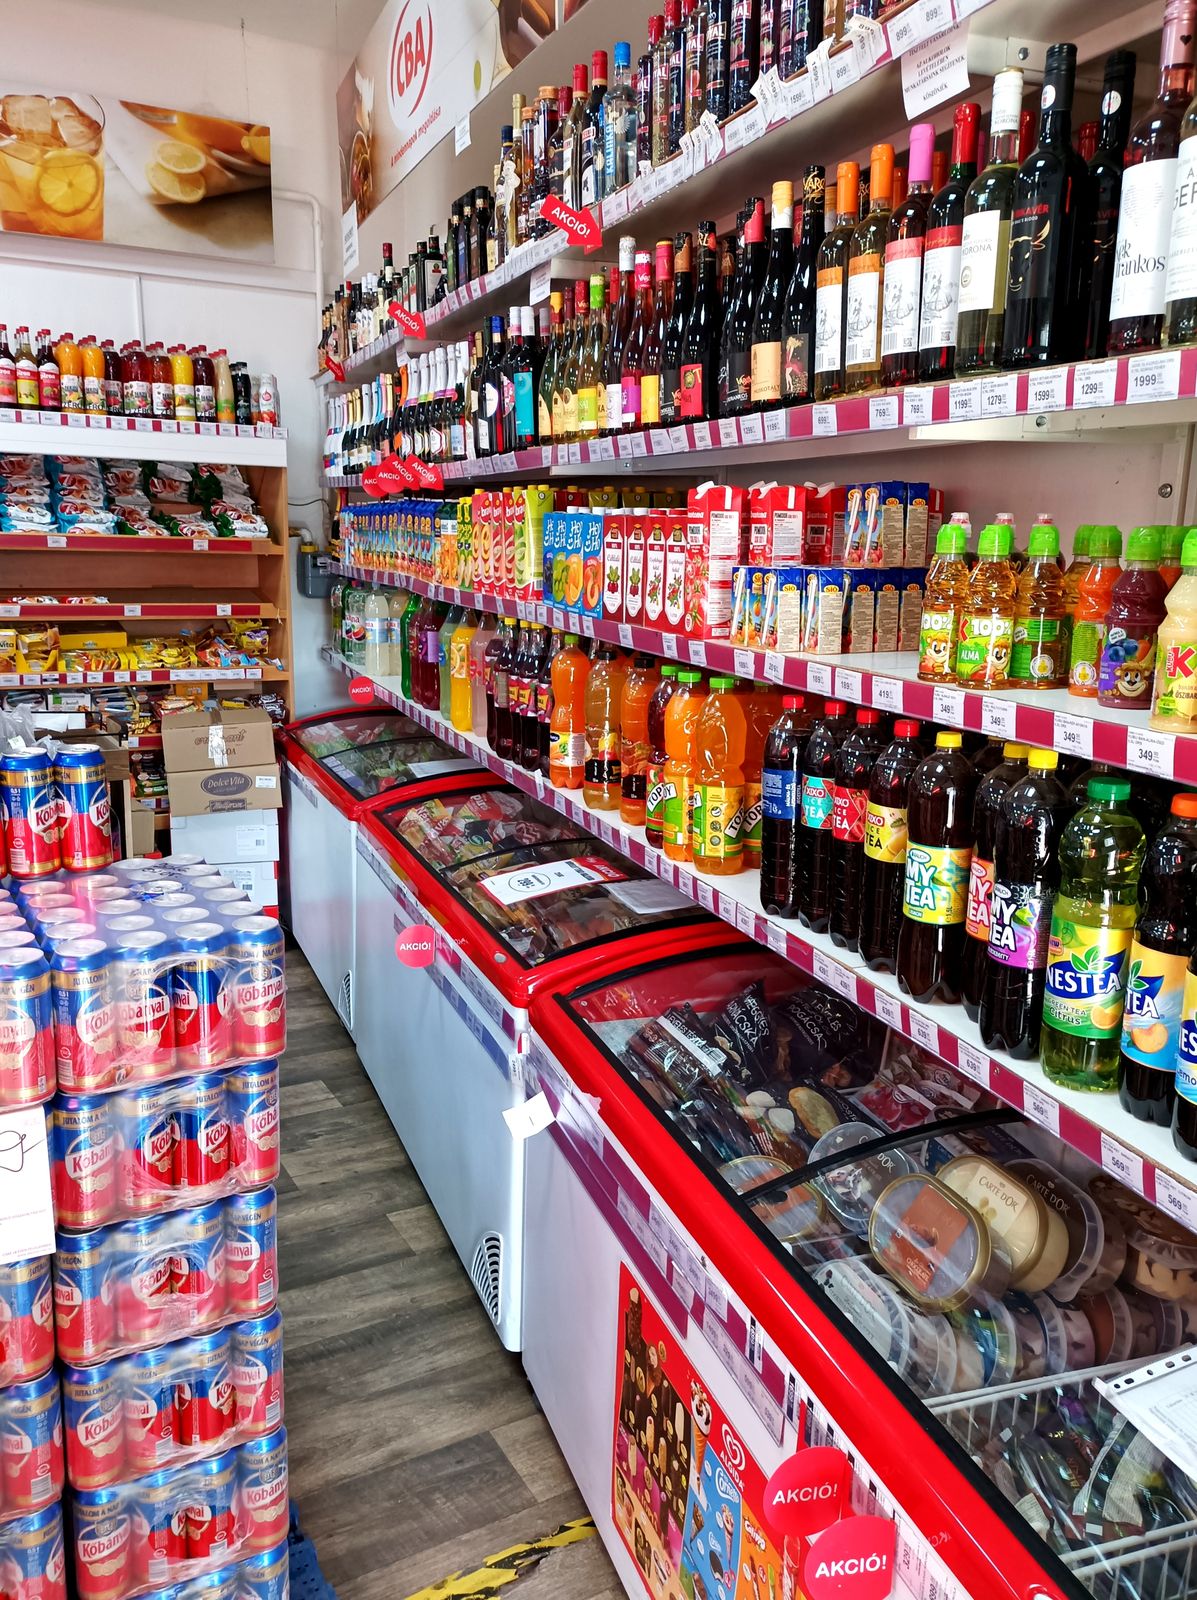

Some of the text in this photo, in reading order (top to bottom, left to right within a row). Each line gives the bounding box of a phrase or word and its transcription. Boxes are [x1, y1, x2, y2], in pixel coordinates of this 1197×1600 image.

[926, 8, 938, 21] 899
[896, 27, 908, 41] 899
[397, 16, 425, 97] CBA
[551, 202, 592, 239] AKCIÓ!
[394, 307, 420, 332] AKCIÓ!
[1081, 382, 1098, 395] 1299
[1134, 374, 1157, 388] 1999
[987, 394, 1002, 406] 1279
[1034, 389, 1050, 402] 1599
[910, 405, 920, 414] 769
[954, 399, 968, 410] 1199
[875, 408, 887, 418] 769
[392, 461, 414, 482] AKCIÓ!
[411, 461, 437, 484] AKCIÓ!
[971, 618, 1012, 636] 100%
[961, 650, 980, 661] ALMA
[1167, 646, 1195, 678] K
[351, 684, 372, 695] AKCIÓ!
[878, 689, 890, 699] 419
[940, 703, 950, 714] 349
[990, 715, 1001, 726] 349
[1063, 731, 1076, 743] 349
[1138, 748, 1153, 761] 349
[207, 776, 245, 789] Dolce Vita
[806, 787, 825, 798] XIXO
[804, 804, 826, 820] TEA
[833, 814, 850, 830] TEA
[865, 832, 883, 850] TEA
[906, 855, 937, 887] MY
[905, 883, 936, 910] TEA
[991, 894, 1018, 926] MY
[399, 940, 432, 952] AKCIÓ!
[1047, 964, 1121, 996] NESTEA
[237, 980, 284, 1005] Kőbányai
[1070, 1006, 1088, 1017] TEA
[1126, 990, 1159, 1020] TEA
[788, 1003, 825, 1040] POGÁCSA
[1050, 1005, 1082, 1026] Citrus
[1112, 1156, 1125, 1172] 569
[978, 1175, 1019, 1213] CARTE D'OR
[1026, 1174, 1071, 1217] CARTE D'OR
[1167, 1193, 1182, 1210] 569
[719, 1450, 745, 1492] ALGIDA
[771, 1482, 838, 1506] AKCIÓ!
[815, 1551, 888, 1580] AKCIÓ!
